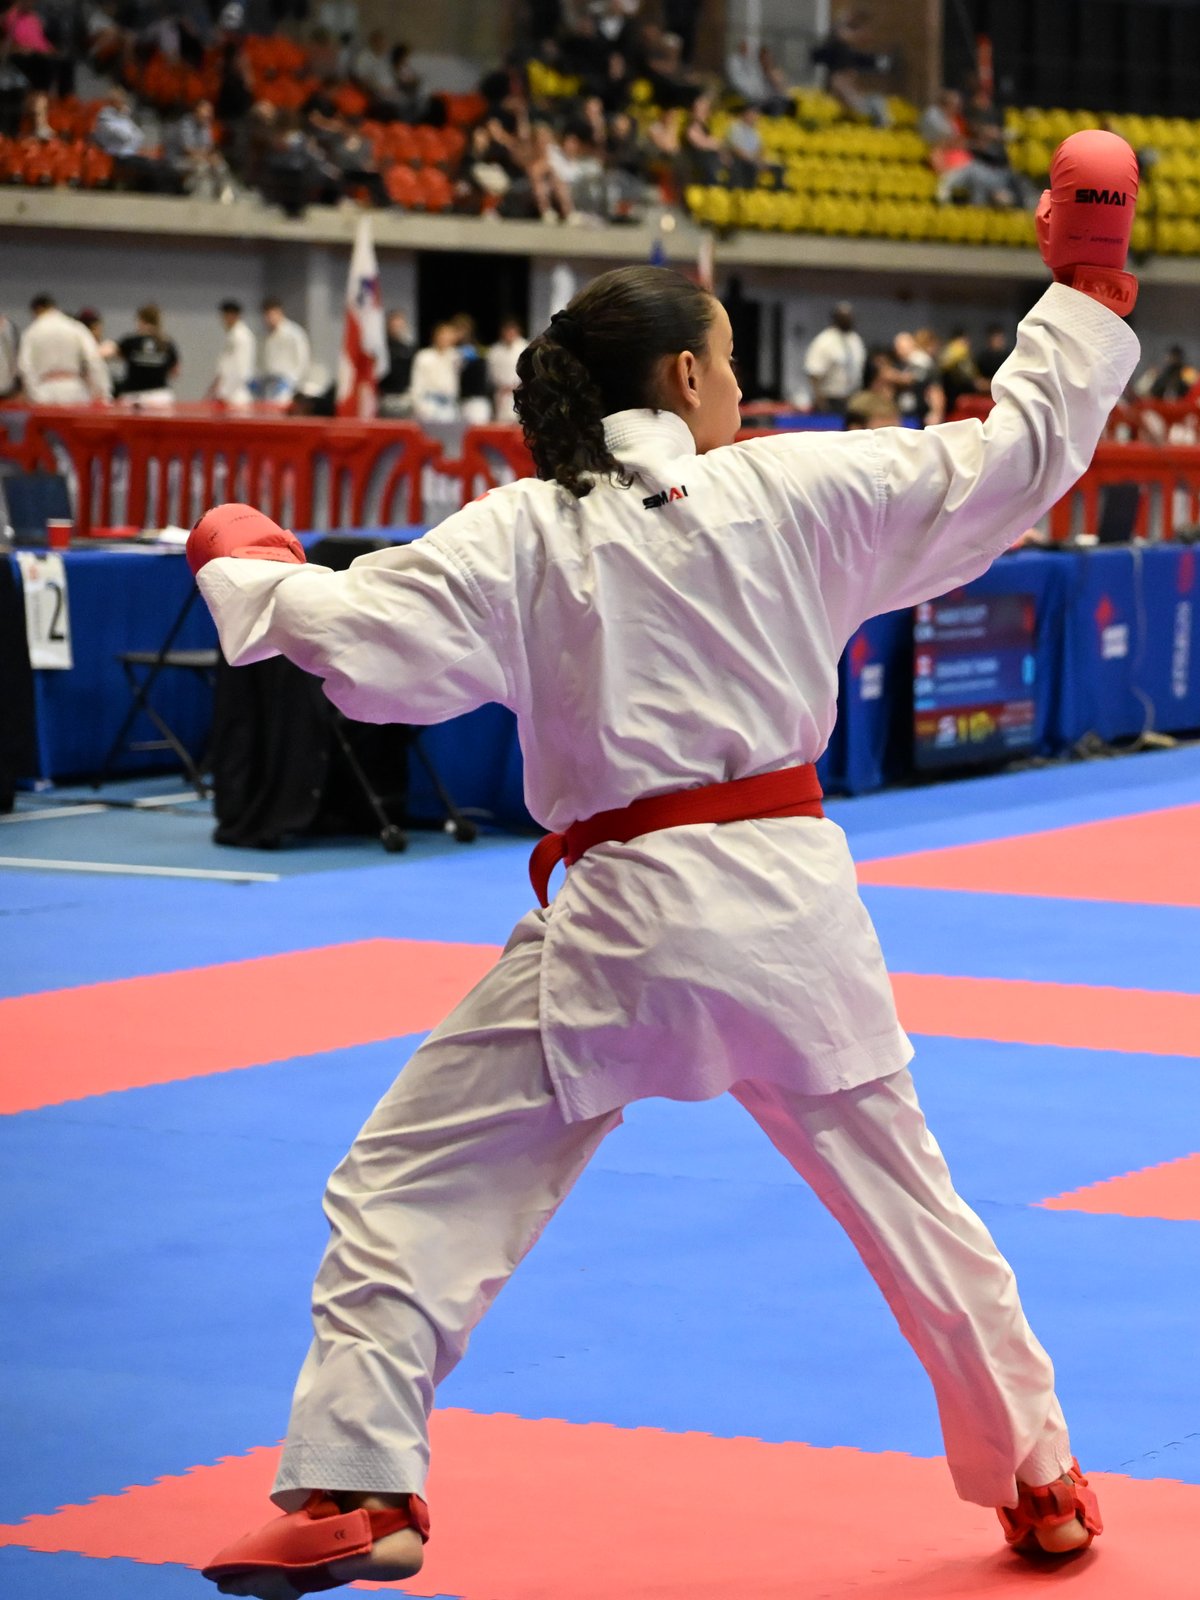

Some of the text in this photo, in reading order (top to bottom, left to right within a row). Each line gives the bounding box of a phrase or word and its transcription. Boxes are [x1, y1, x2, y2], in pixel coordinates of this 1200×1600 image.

[1075, 189, 1127, 207] SMAI
[642, 484, 689, 510] SMAI
[45, 581, 65, 641] 2
